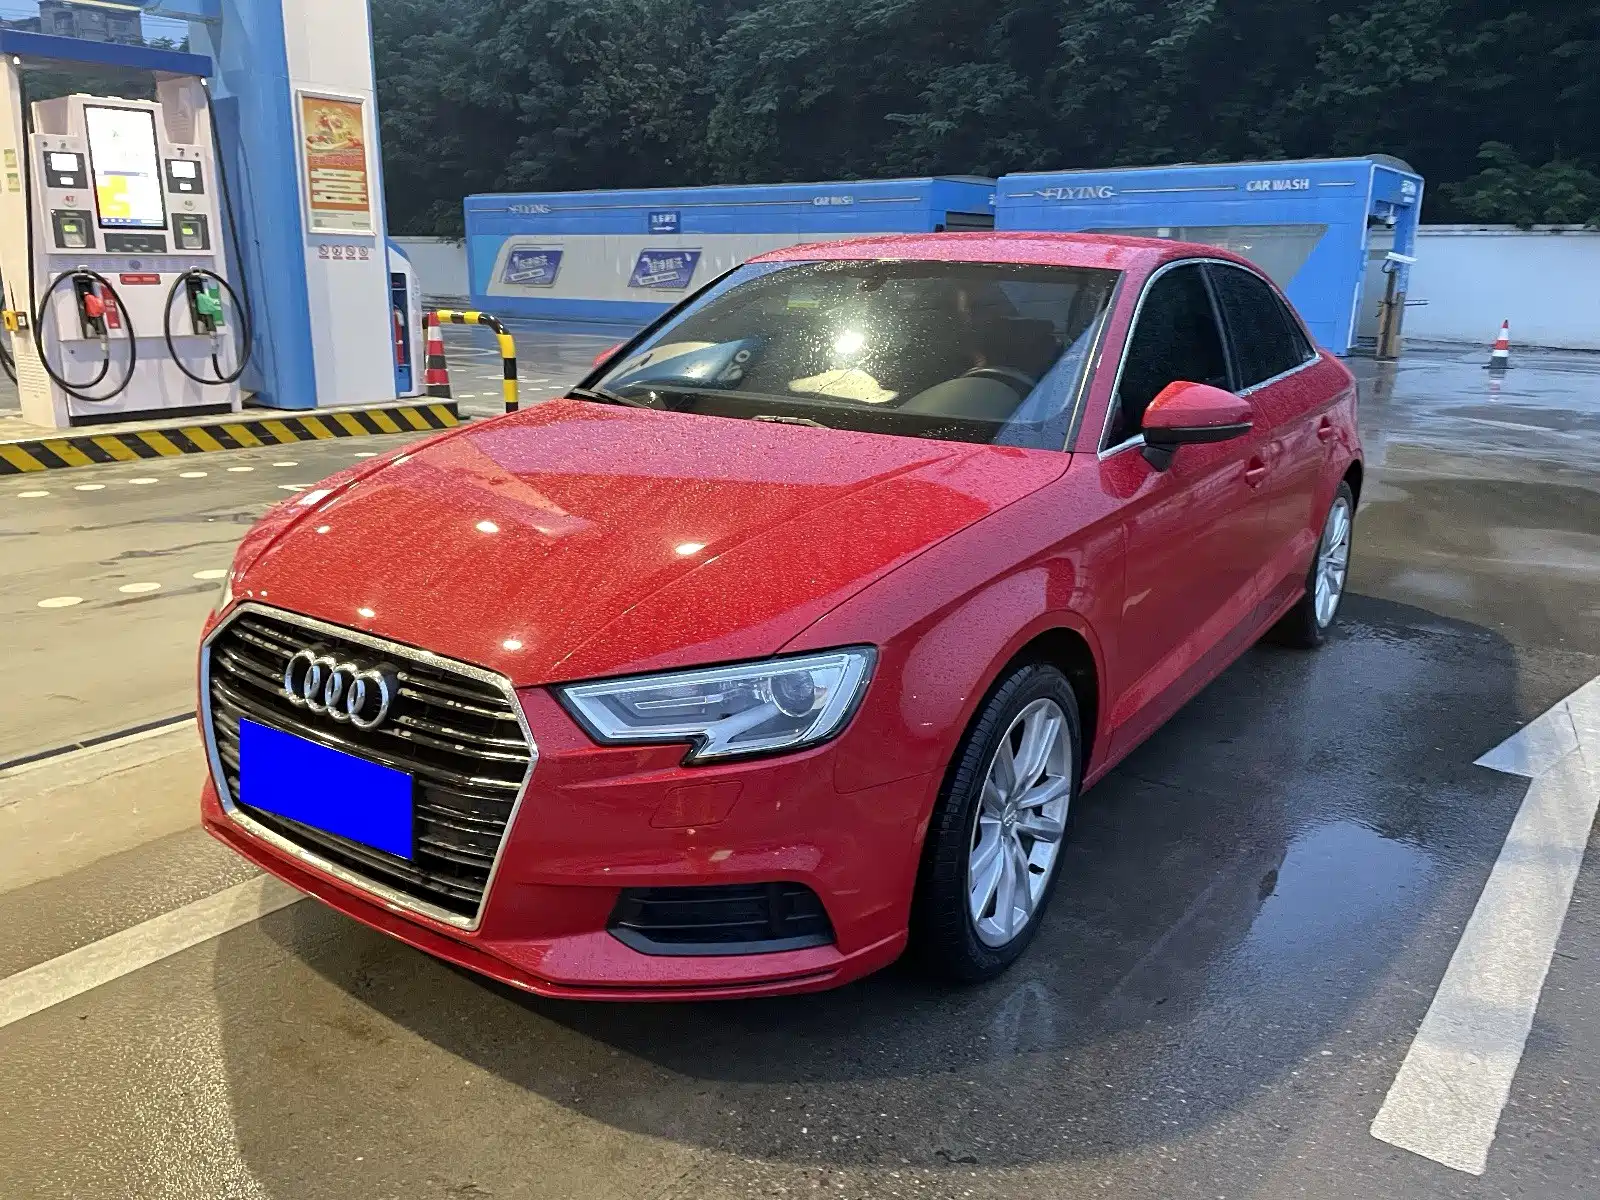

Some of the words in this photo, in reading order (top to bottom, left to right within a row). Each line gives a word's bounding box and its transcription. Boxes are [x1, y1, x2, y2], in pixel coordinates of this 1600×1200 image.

[1246, 180, 1271, 191] CAR
[1272, 179, 1309, 190] WASH
[1038, 186, 1118, 200] FLYING
